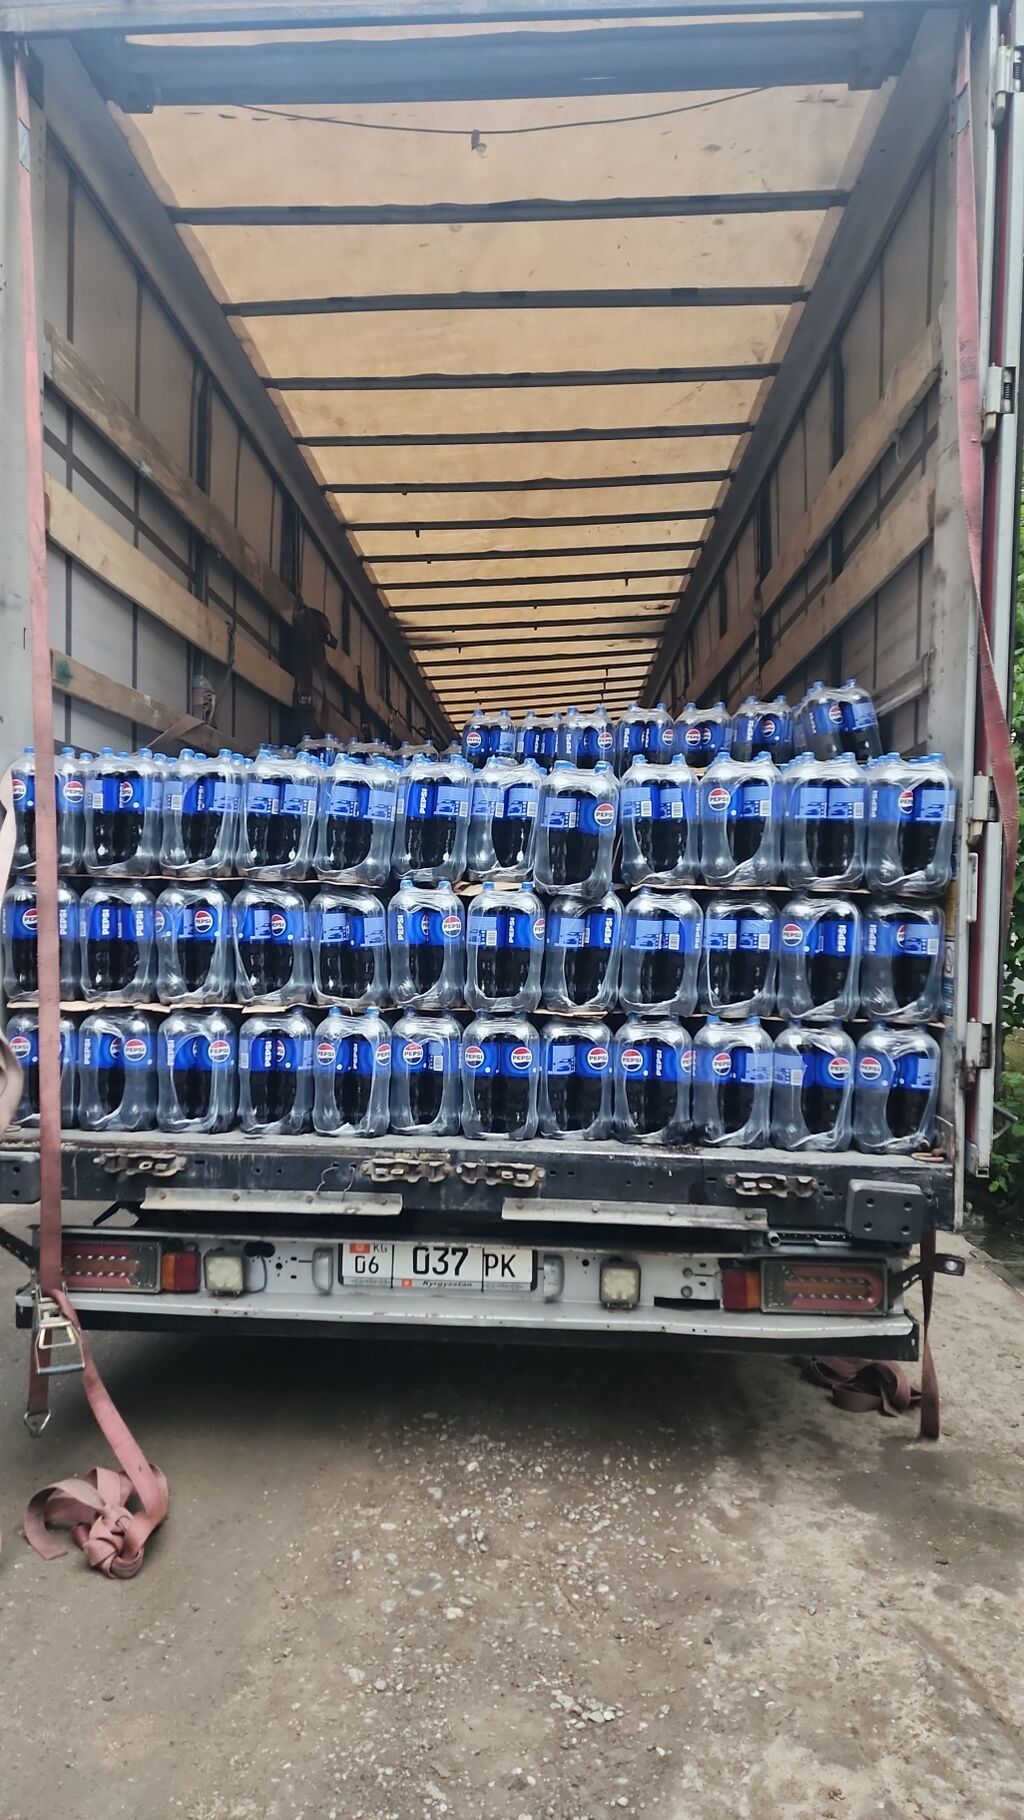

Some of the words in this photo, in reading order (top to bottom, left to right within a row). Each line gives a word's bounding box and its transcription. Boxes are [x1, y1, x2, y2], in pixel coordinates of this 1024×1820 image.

[420, 788, 428, 814] PEPSI
[59, 909, 67, 935] PEPSI
[102, 909, 110, 935] PEPSI
[136, 910, 144, 937] PEPSI
[195, 918, 212, 926] PEPSI
[604, 917, 613, 944] PEPSI
[837, 924, 847, 952] PEPSI
[869, 924, 877, 952] PEPSI
[264, 1040, 272, 1067] PEPSI
[655, 1049, 663, 1076] PEPSI
[373, 1243, 387, 1253] KG
[355, 1255, 379, 1274] 06
[413, 1247, 468, 1276] 037
[484, 1254, 516, 1278] PK
